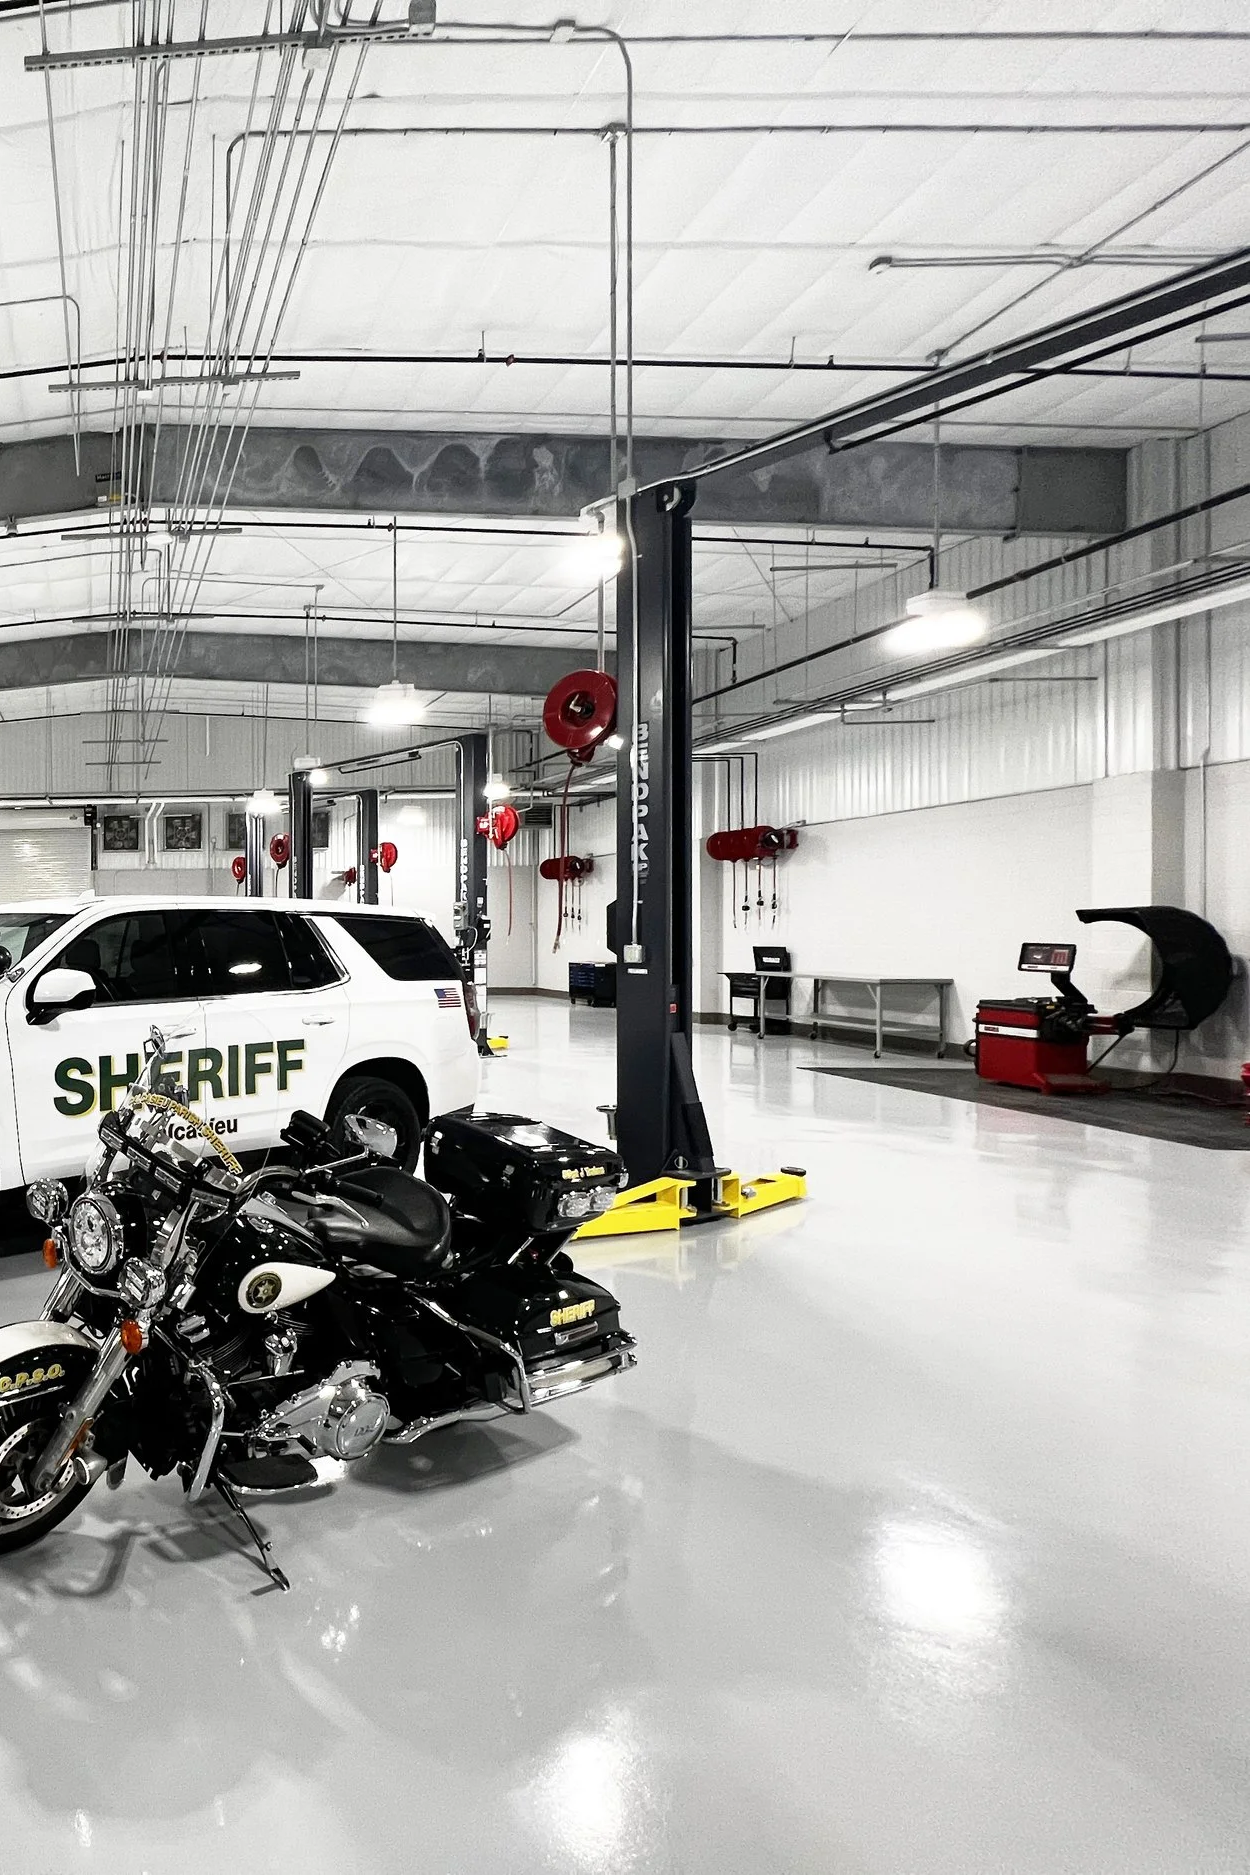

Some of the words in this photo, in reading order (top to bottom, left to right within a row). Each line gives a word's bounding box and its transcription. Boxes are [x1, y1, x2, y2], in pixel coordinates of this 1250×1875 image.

[53, 1039, 307, 1117] SHERIFF
[200, 1124, 244, 1175] SHERIFF
[550, 1299, 595, 1327] SHERIFF
